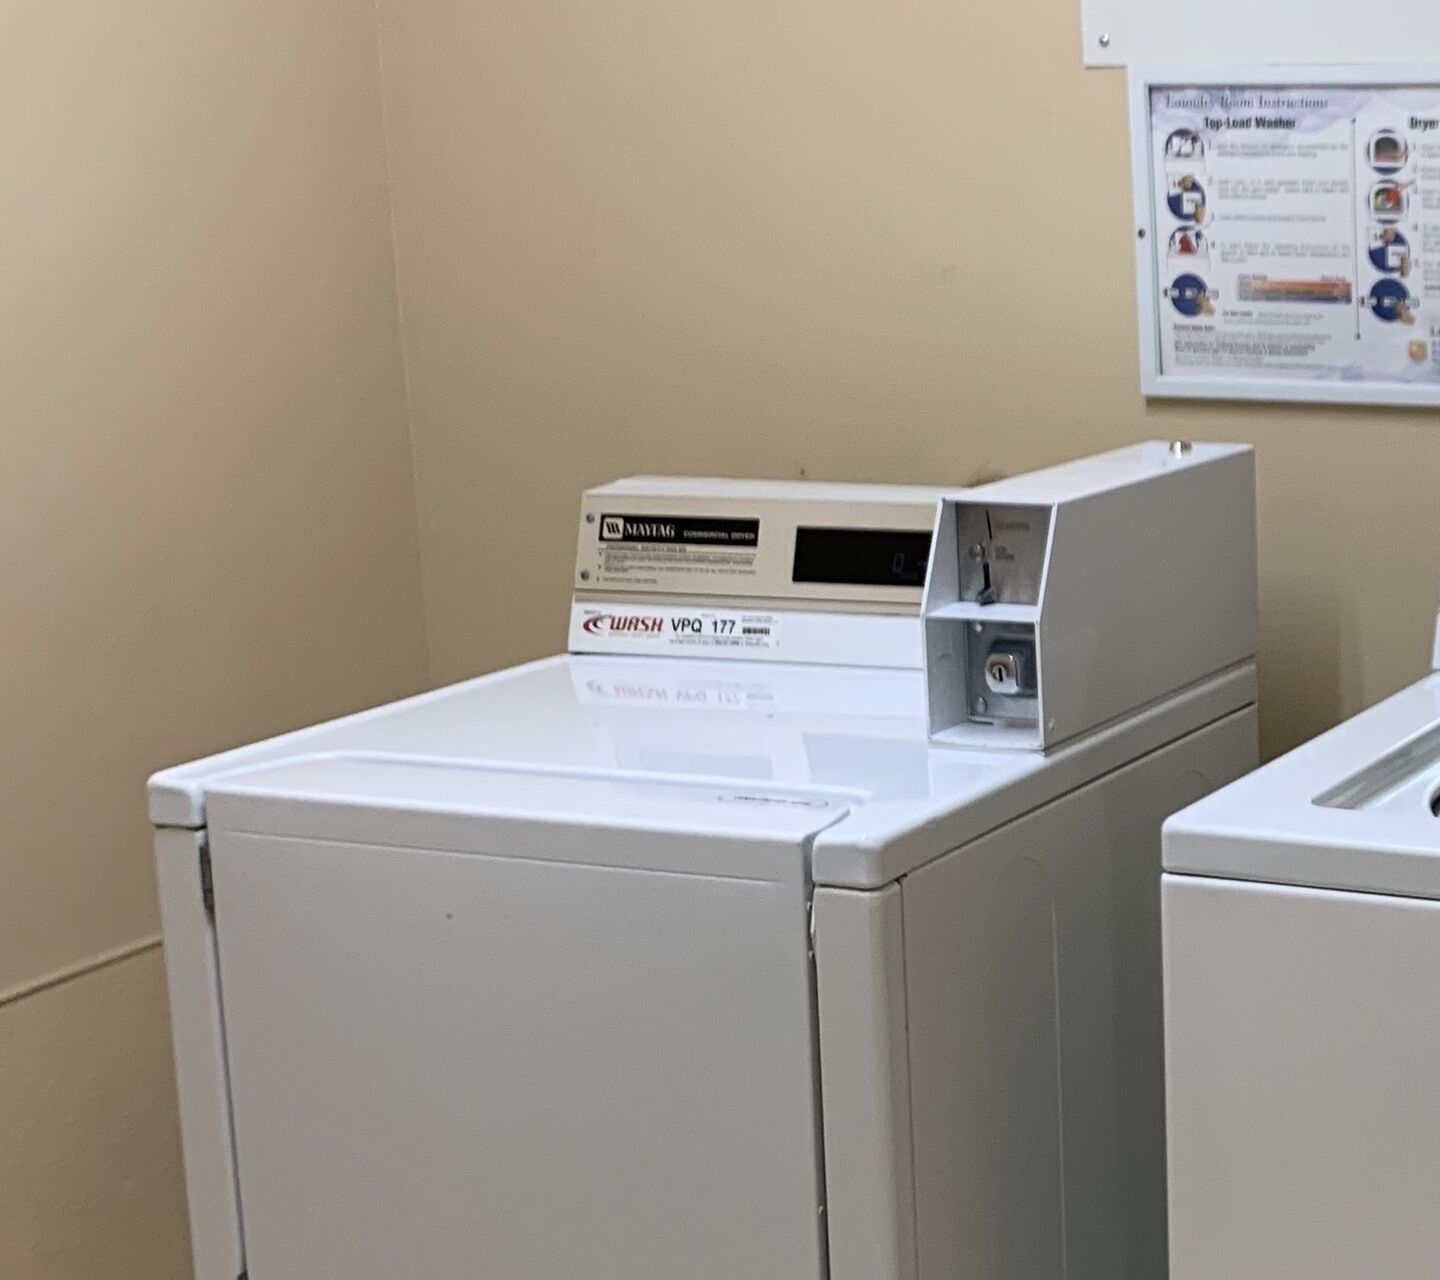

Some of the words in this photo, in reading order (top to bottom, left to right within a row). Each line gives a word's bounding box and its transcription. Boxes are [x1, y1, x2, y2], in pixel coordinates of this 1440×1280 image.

[1204, 116, 1251, 131] Top-Load
[1254, 116, 1297, 130] Washer
[1408, 117, 1440, 132] Dryer
[624, 521, 676, 539] MAYTAG
[609, 615, 665, 634] WASH
[671, 617, 703, 634] VPQ
[711, 619, 737, 635] 177
